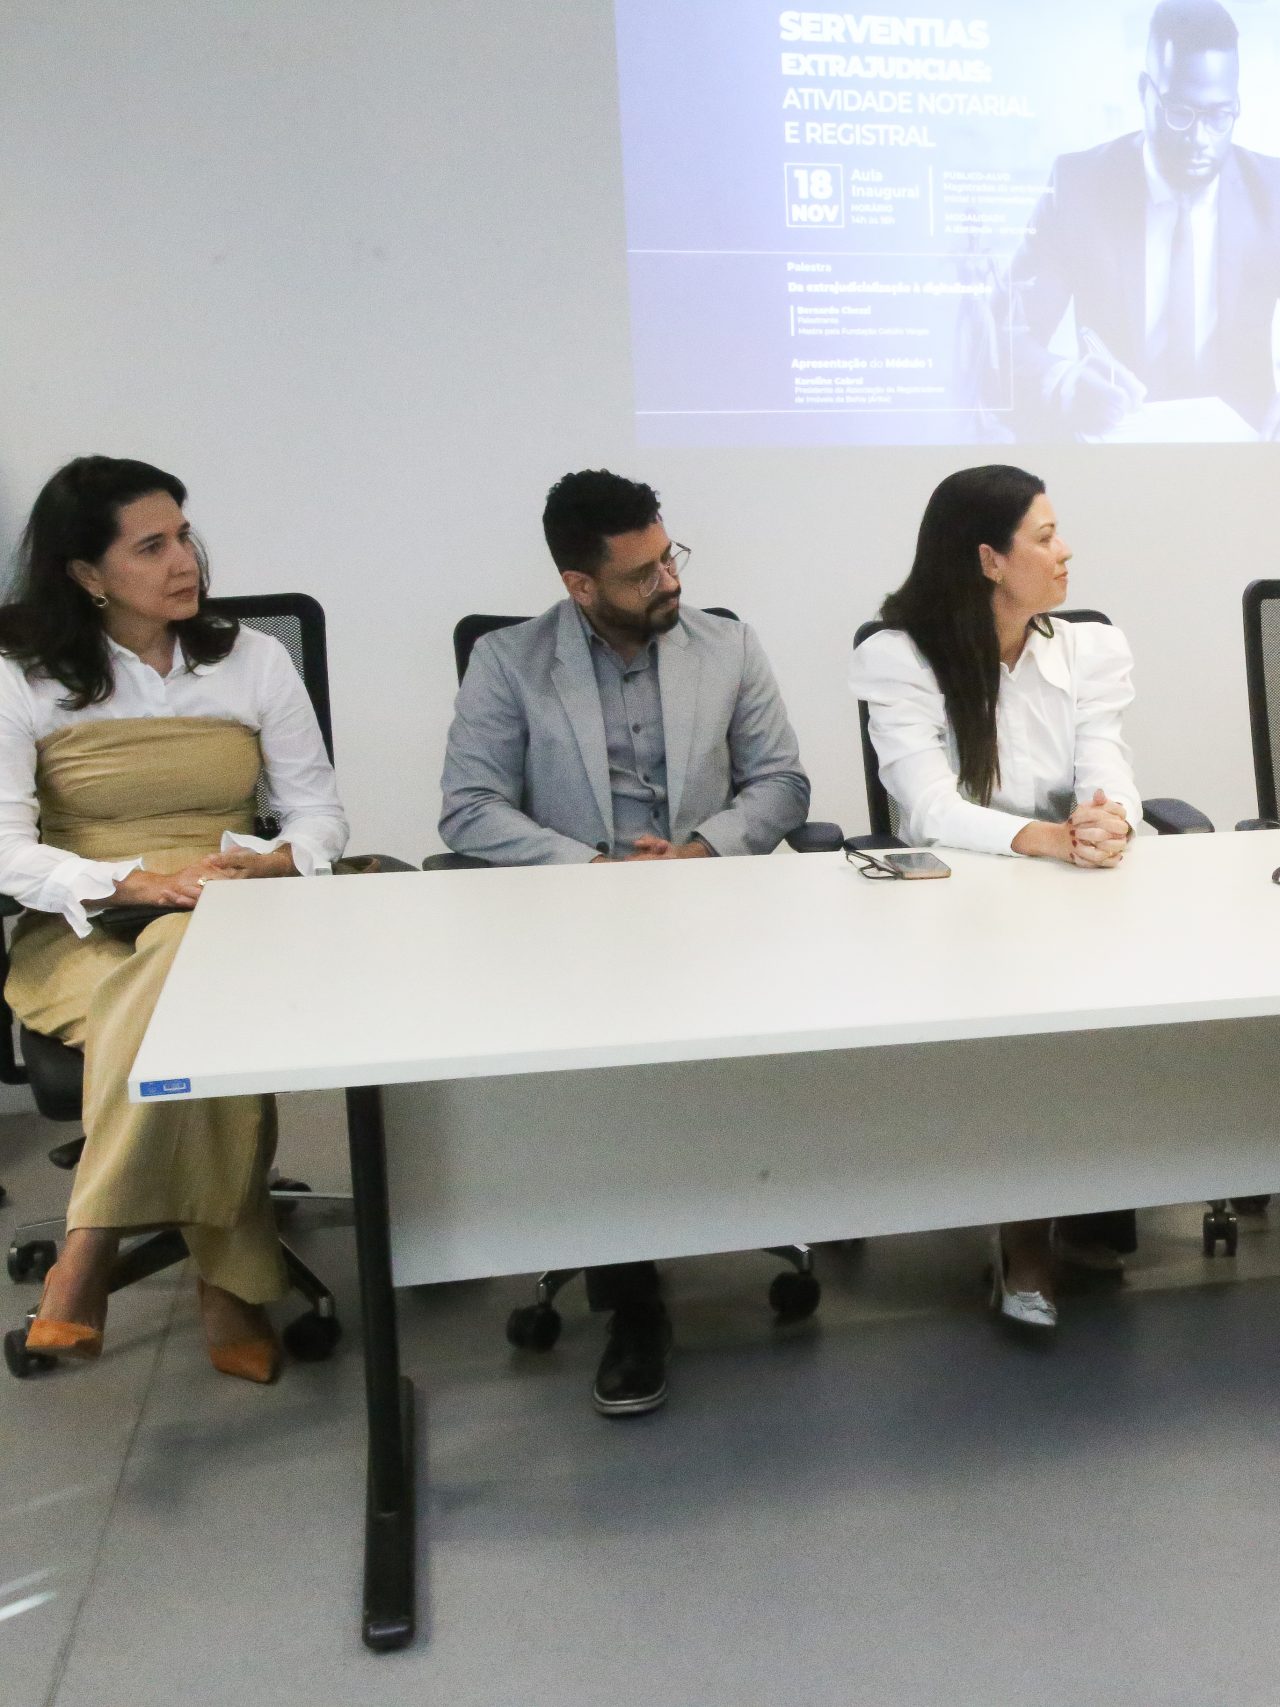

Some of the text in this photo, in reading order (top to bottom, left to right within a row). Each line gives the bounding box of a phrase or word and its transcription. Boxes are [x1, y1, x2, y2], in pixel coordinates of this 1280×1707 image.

[779, 10, 990, 49] SERVENTIAS
[782, 87, 1035, 117] ATIVIDADE NOTARIAL
[784, 121, 936, 147] E REGISTRAL
[850, 168, 882, 182] Aula
[793, 169, 833, 200] 18
[851, 184, 920, 200] Inaugural
[791, 204, 840, 222] NOV
[786, 261, 832, 273] Palestra
[791, 357, 868, 371] Apresentação
[869, 357, 883, 369] do
